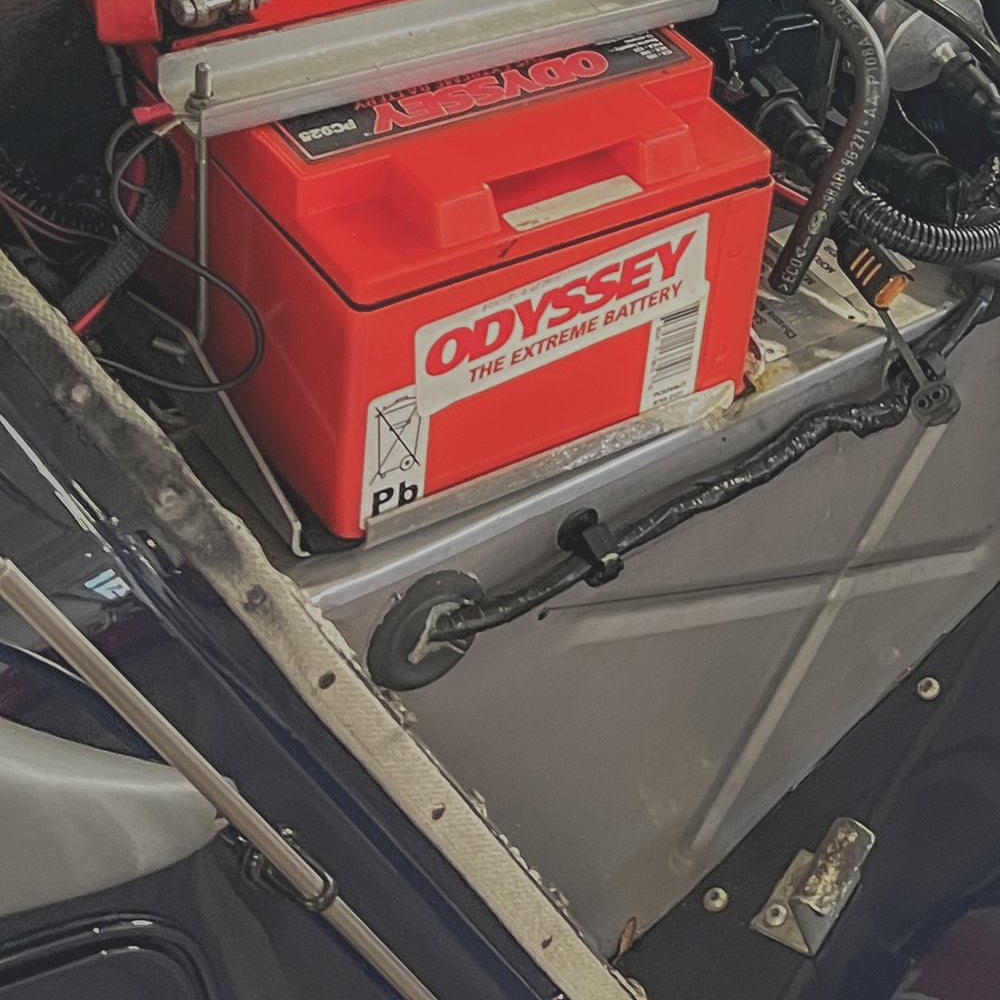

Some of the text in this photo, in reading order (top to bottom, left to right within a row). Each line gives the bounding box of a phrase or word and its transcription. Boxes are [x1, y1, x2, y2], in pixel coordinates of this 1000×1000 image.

[372, 50, 609, 135] ODYSSEY
[424, 230, 697, 377] ODYSSEY
[469, 359, 504, 384] THE
[510, 319, 598, 366] EXTREME
[602, 279, 684, 327] BATTERY
[371, 481, 419, 516] Pb
